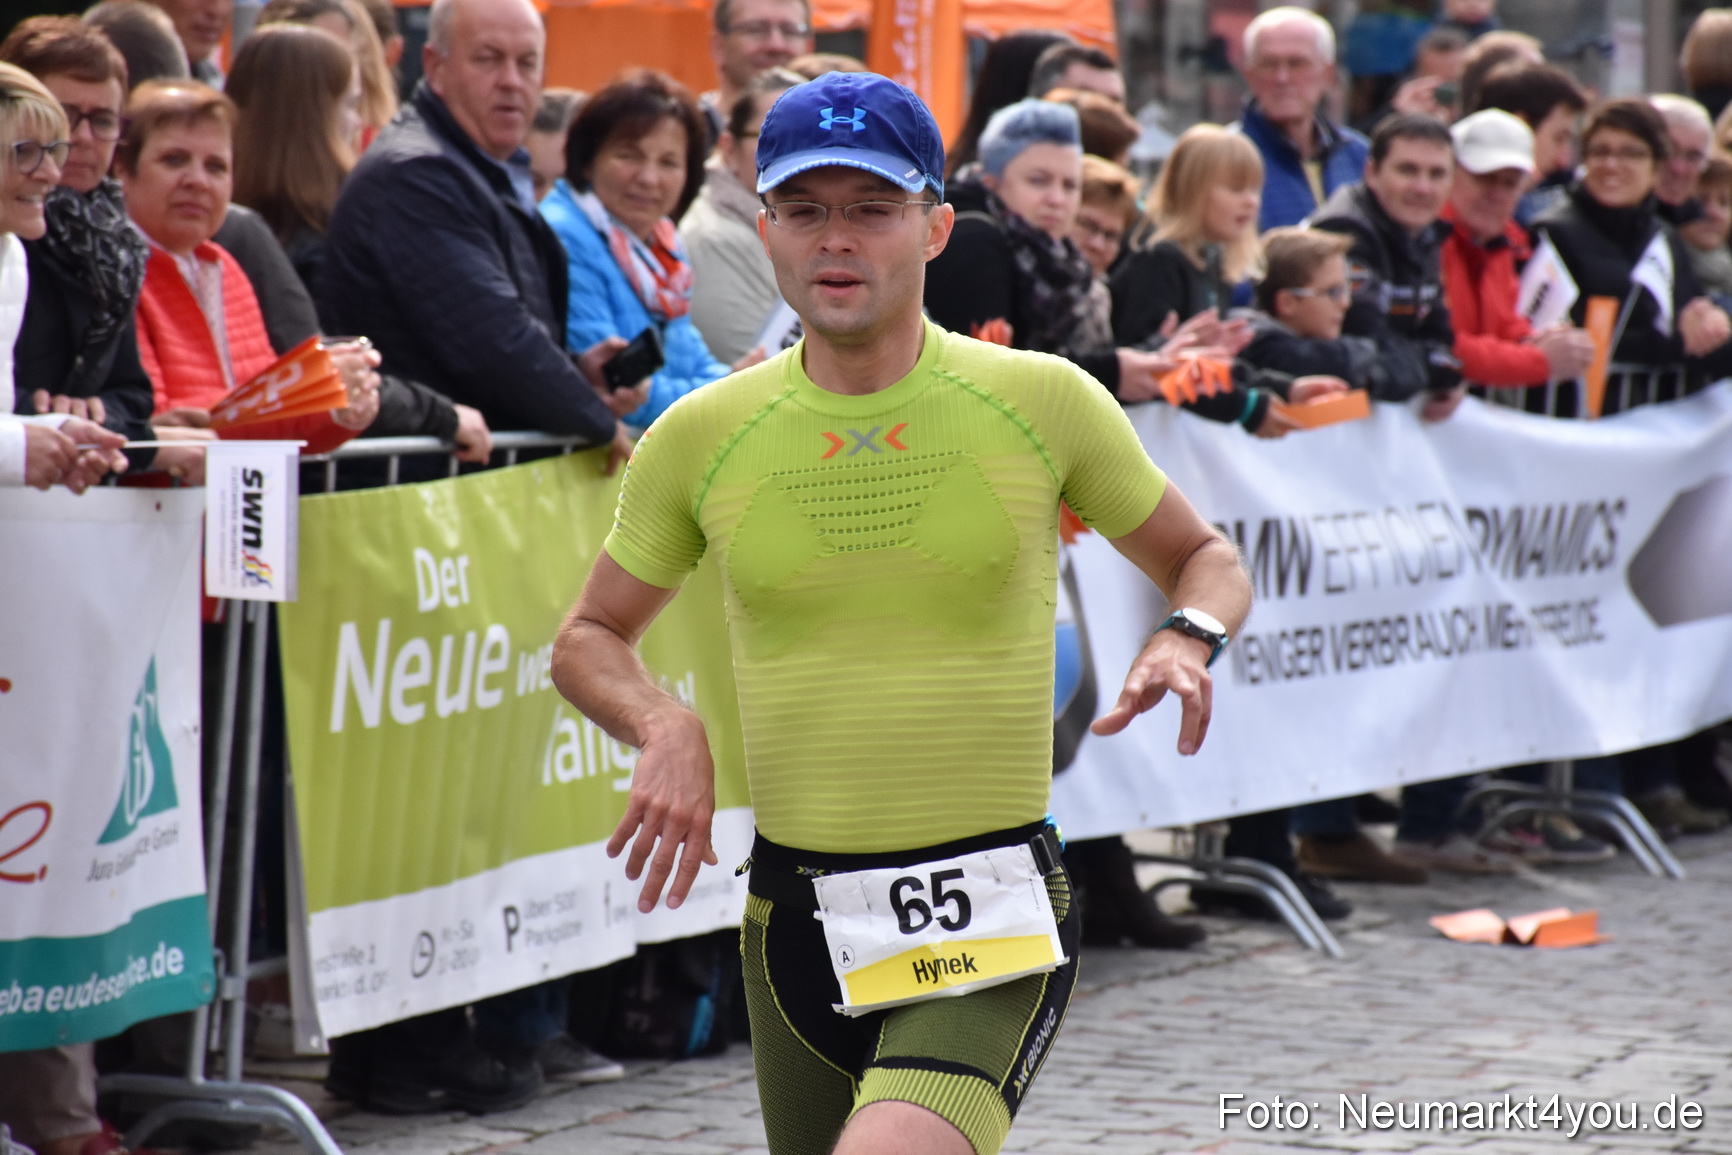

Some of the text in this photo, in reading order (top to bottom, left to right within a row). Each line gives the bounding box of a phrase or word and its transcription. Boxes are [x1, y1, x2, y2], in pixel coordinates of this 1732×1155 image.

[242, 467, 263, 549] swn
[413, 547, 470, 612] Der
[1209, 518, 1313, 600] MW
[330, 618, 510, 733] Neue
[889, 868, 972, 935] 65
[0, 941, 185, 1016] ebaeudeseice.de
[842, 951, 850, 963] A
[912, 952, 979, 985] Hynek
